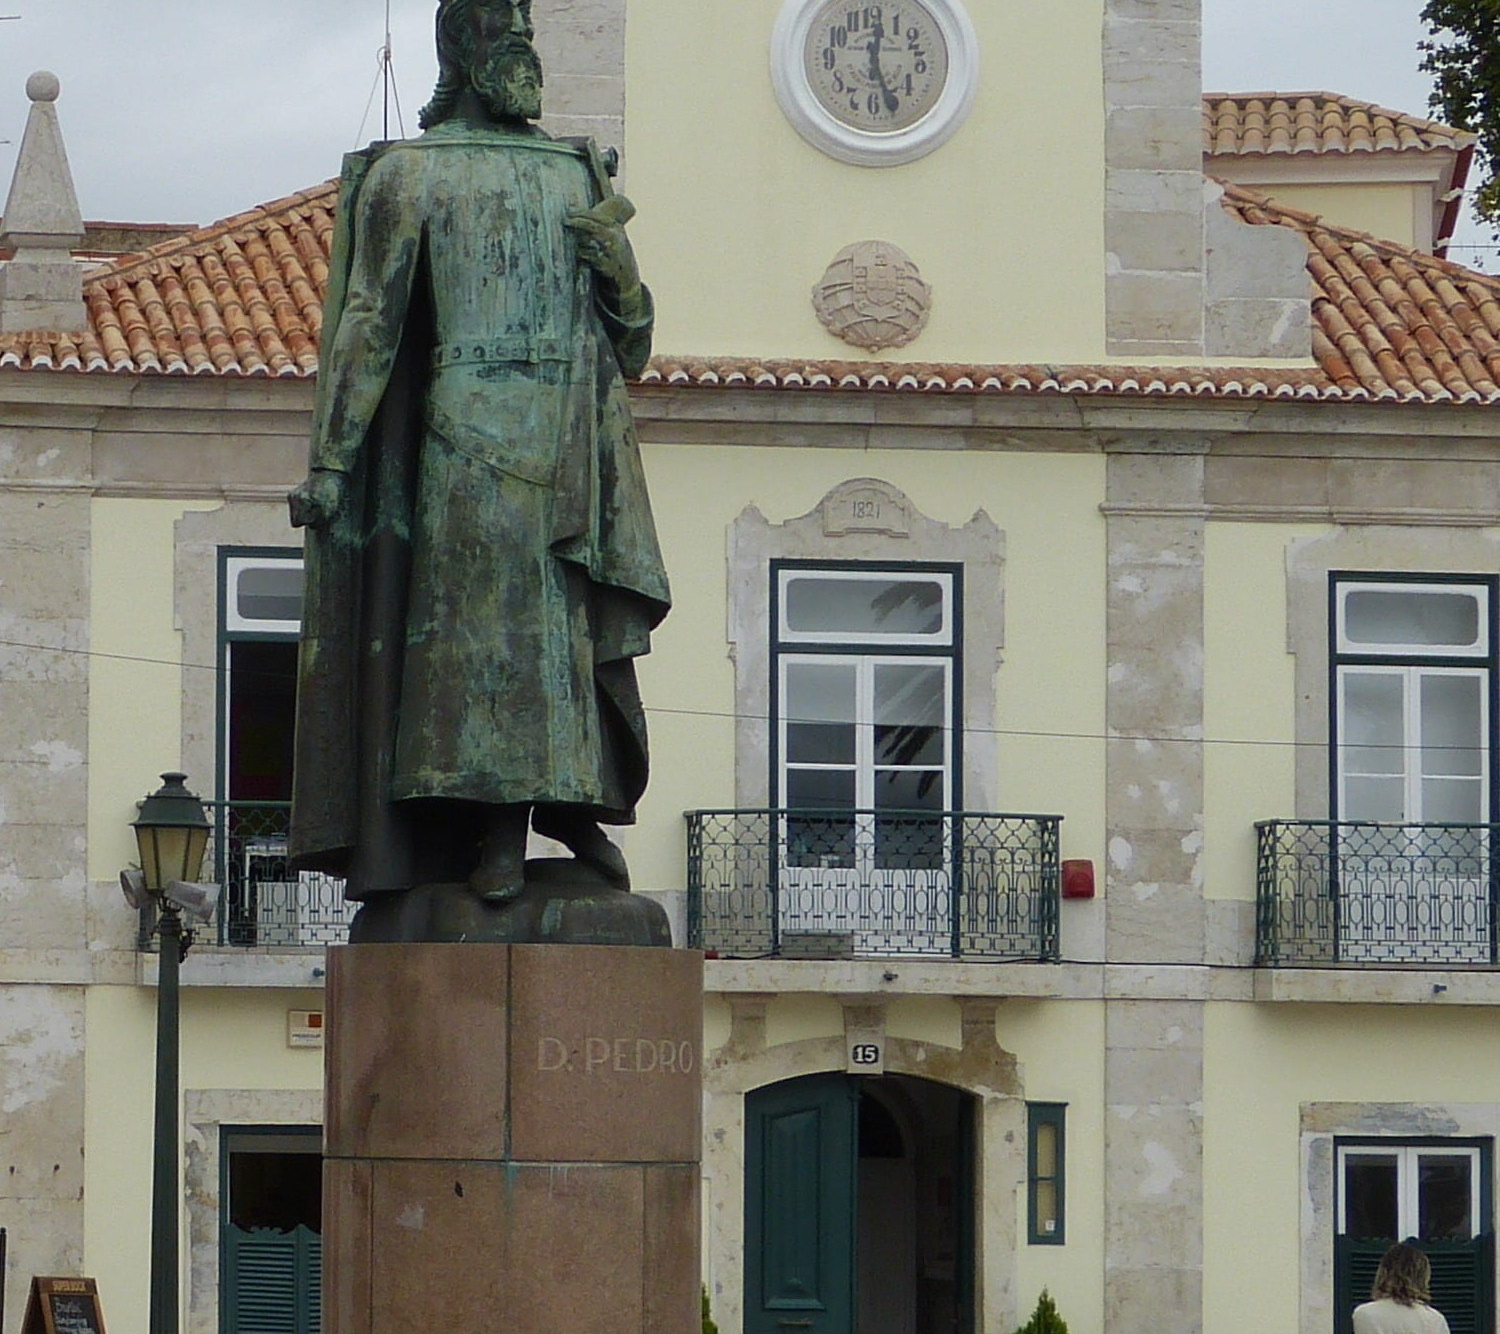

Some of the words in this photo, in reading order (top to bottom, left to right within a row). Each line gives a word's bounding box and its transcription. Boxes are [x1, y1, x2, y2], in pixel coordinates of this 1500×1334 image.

[846, 11, 859, 33] 11
[892, 13, 900, 36] 1
[829, 26, 848, 48] 10
[906, 27, 920, 51] 2
[822, 47, 836, 71] 9
[913, 50, 927, 75] 3
[831, 70, 844, 94] 8
[899, 73, 913, 97] 4
[846, 86, 860, 112] 7
[867, 92, 880, 115] 6
[852, 500, 880, 520] 1821
[537, 1036, 575, 1073] D.
[584, 1037, 694, 1074] PEDRO
[855, 1046, 877, 1063] 15
